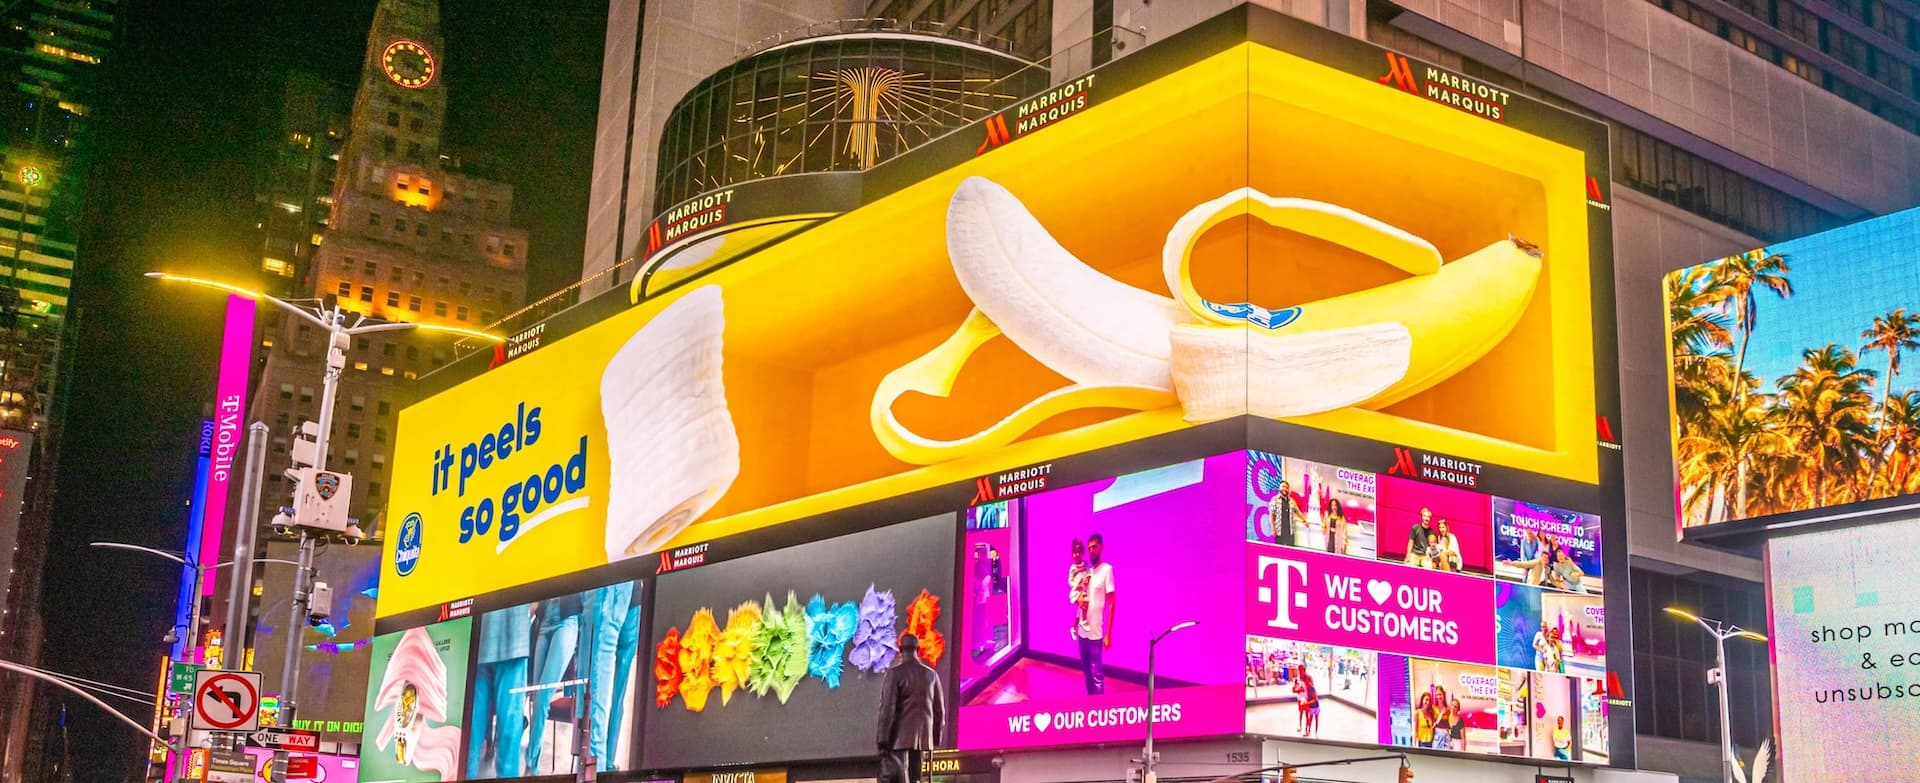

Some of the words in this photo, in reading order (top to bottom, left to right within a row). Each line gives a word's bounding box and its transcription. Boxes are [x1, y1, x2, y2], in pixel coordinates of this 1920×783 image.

[1019, 74, 1095, 118] MARRIOTT
[1427, 67, 1509, 105] MARRIOTT
[1428, 84, 1500, 119] MARQUIS
[1018, 96, 1085, 134] MARQUIS
[668, 190, 734, 225] MARRIOTT
[1586, 199, 1610, 211] ARRIOTT
[666, 209, 722, 241] MARQUIS
[508, 338, 539, 359] MARQUIS
[432, 443, 454, 496] it
[458, 401, 541, 498] peels
[1000, 463, 1053, 485] MARRIOTT
[1422, 454, 1482, 475] MARRIOTT
[1347, 480, 1361, 491] THE
[1423, 467, 1475, 486] MARQUIS
[459, 497, 494, 544] so
[499, 434, 588, 542] good
[998, 478, 1045, 497] MARQUIS
[1510, 513, 1540, 529] TOUCH
[1540, 520, 1572, 535] SCREEN
[1573, 525, 1584, 537] TO
[674, 543, 709, 559] MARRIOTT
[674, 553, 704, 568] MARQUIS
[1324, 573, 1362, 602] WE
[1397, 585, 1442, 613] OUR
[1324, 604, 1459, 646] CUSTOMERS
[1811, 625, 1872, 643] shop
[1861, 652, 1877, 670] &
[1470, 685, 1483, 695] THE
[314, 720, 326, 732] IT
[327, 720, 342, 732] ON
[1008, 715, 1031, 733] WE
[1053, 711, 1084, 730] OUR
[1087, 703, 1182, 727] CUSTOMERS
[257, 733, 278, 744] ONE
[288, 735, 312, 745] WAY
[1226, 751, 1250, 763] 1535
